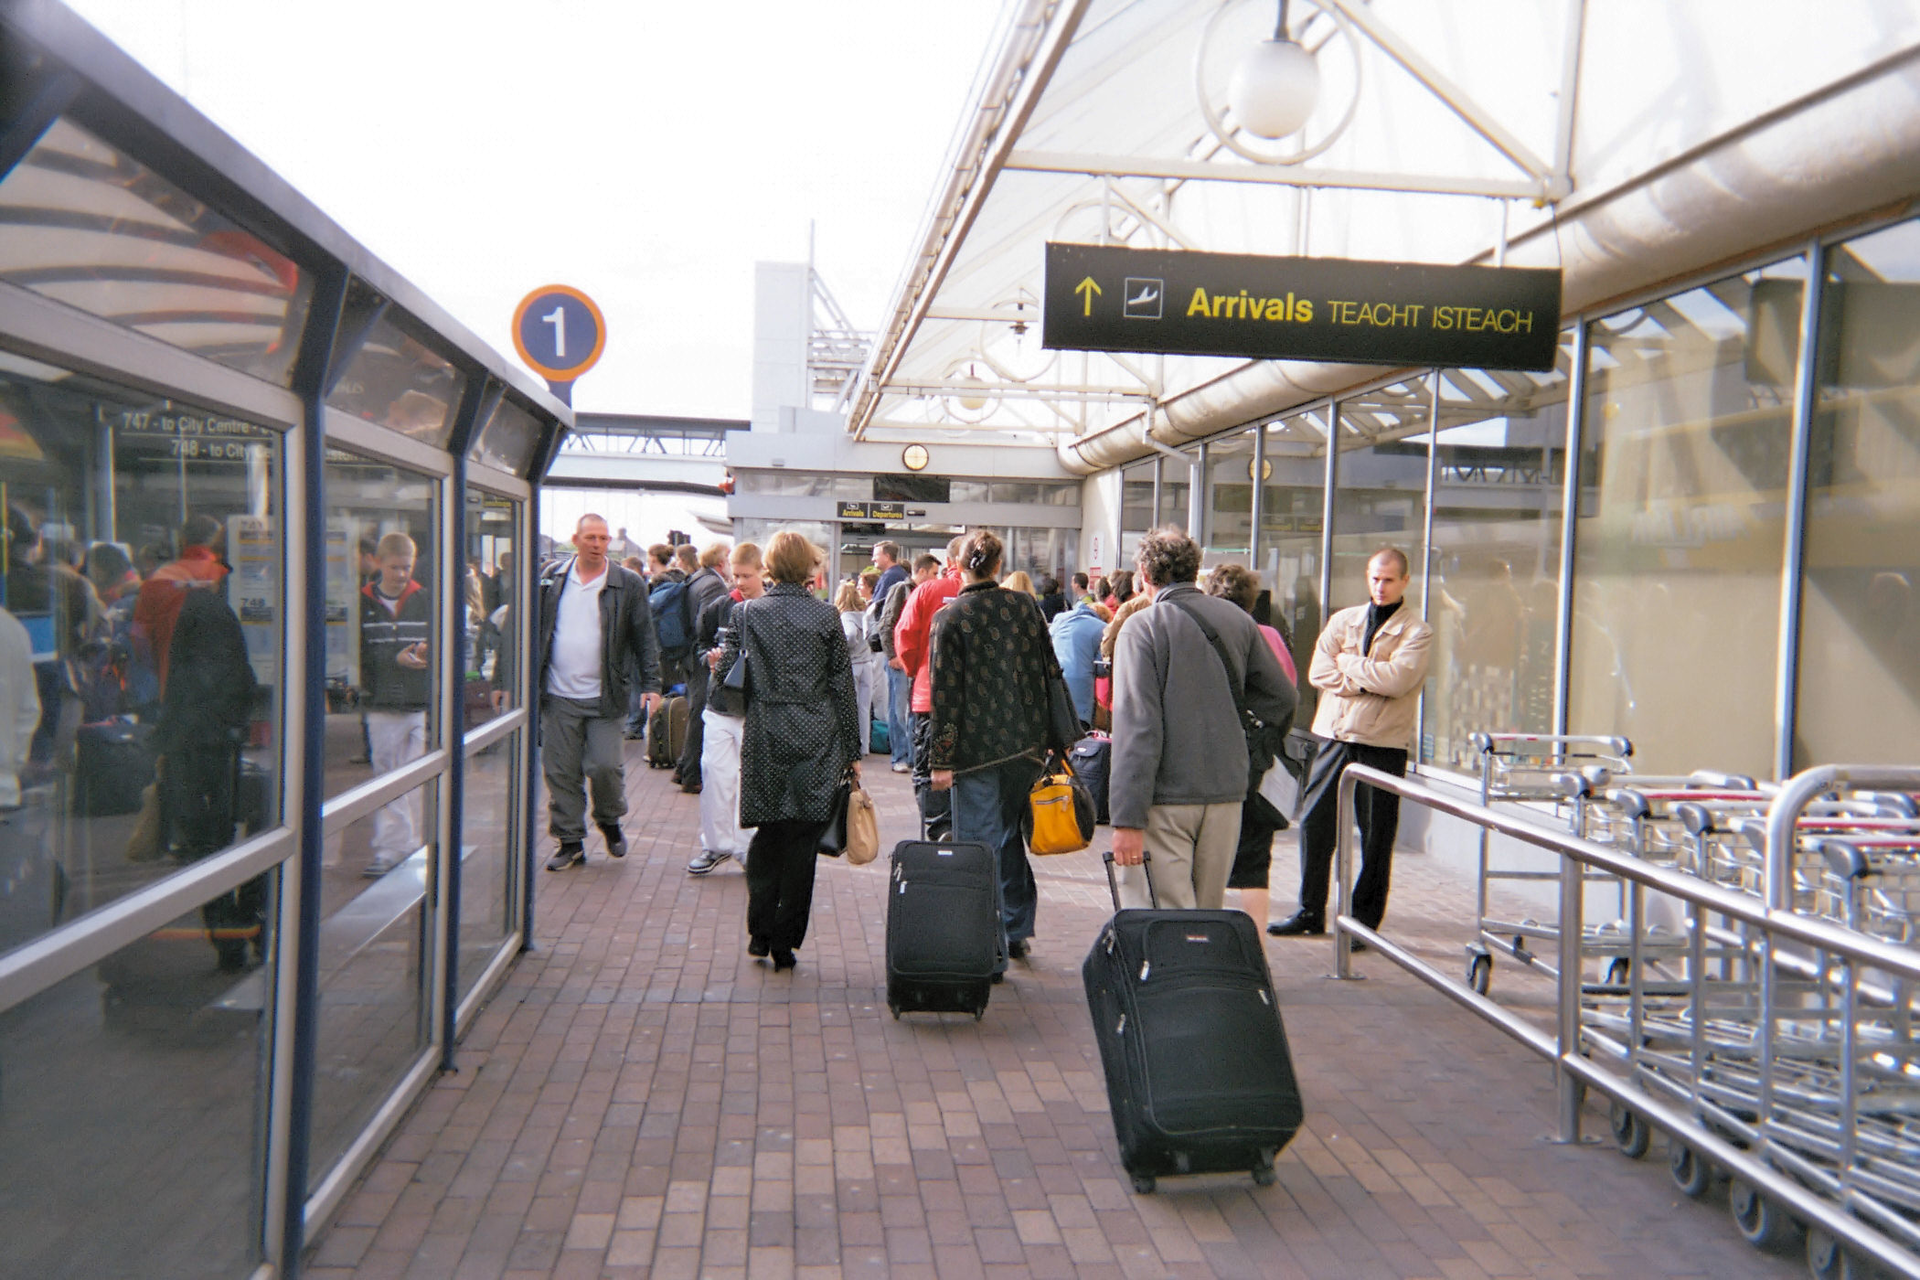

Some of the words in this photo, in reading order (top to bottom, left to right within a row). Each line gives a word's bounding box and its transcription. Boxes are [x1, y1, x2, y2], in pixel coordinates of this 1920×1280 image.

[1187, 287, 1314, 323] Arrivals
[1327, 300, 1424, 327] TEACHT
[1432, 305, 1534, 334] ISTEACH
[541, 306, 565, 357] 1
[122, 412, 149, 430] 747
[161, 416, 175, 431] to
[178, 416, 204, 434] City
[206, 417, 250, 433] Centre
[171, 439, 199, 457] 748
[209, 443, 223, 458] to
[225, 443, 250, 461] City
[872, 510, 903, 518] Departures
